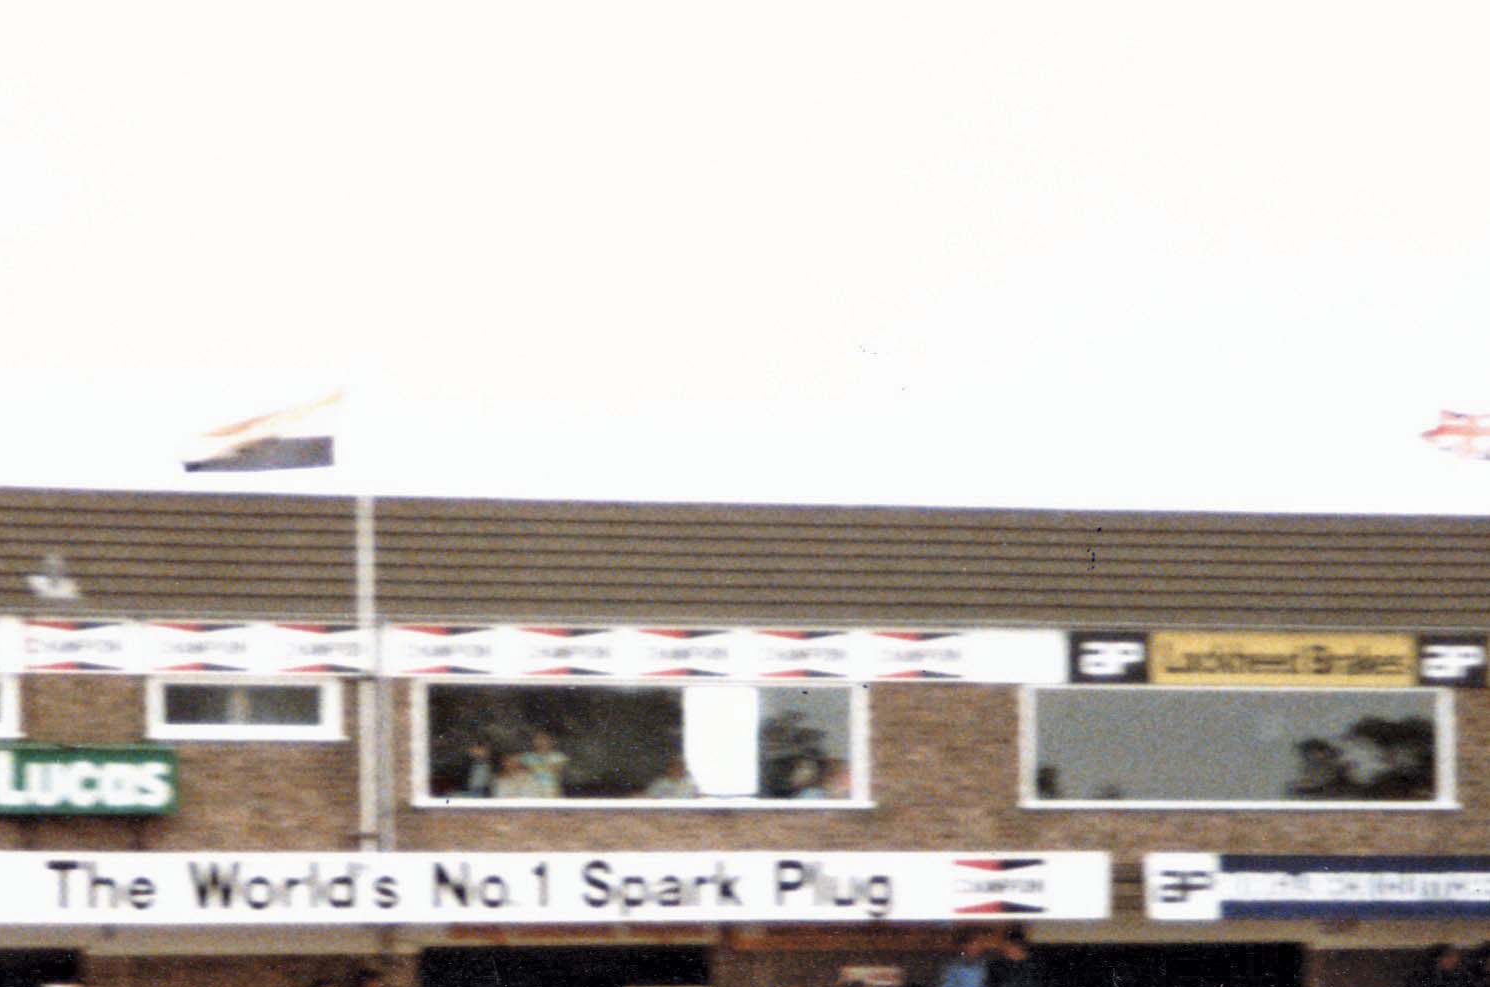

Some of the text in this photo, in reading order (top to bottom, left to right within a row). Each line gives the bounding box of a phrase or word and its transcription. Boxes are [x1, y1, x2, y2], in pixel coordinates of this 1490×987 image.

[46, 860, 157, 910] The
[188, 860, 400, 910] World's
[581, 860, 744, 918] Spark
[773, 860, 894, 920] Plug
